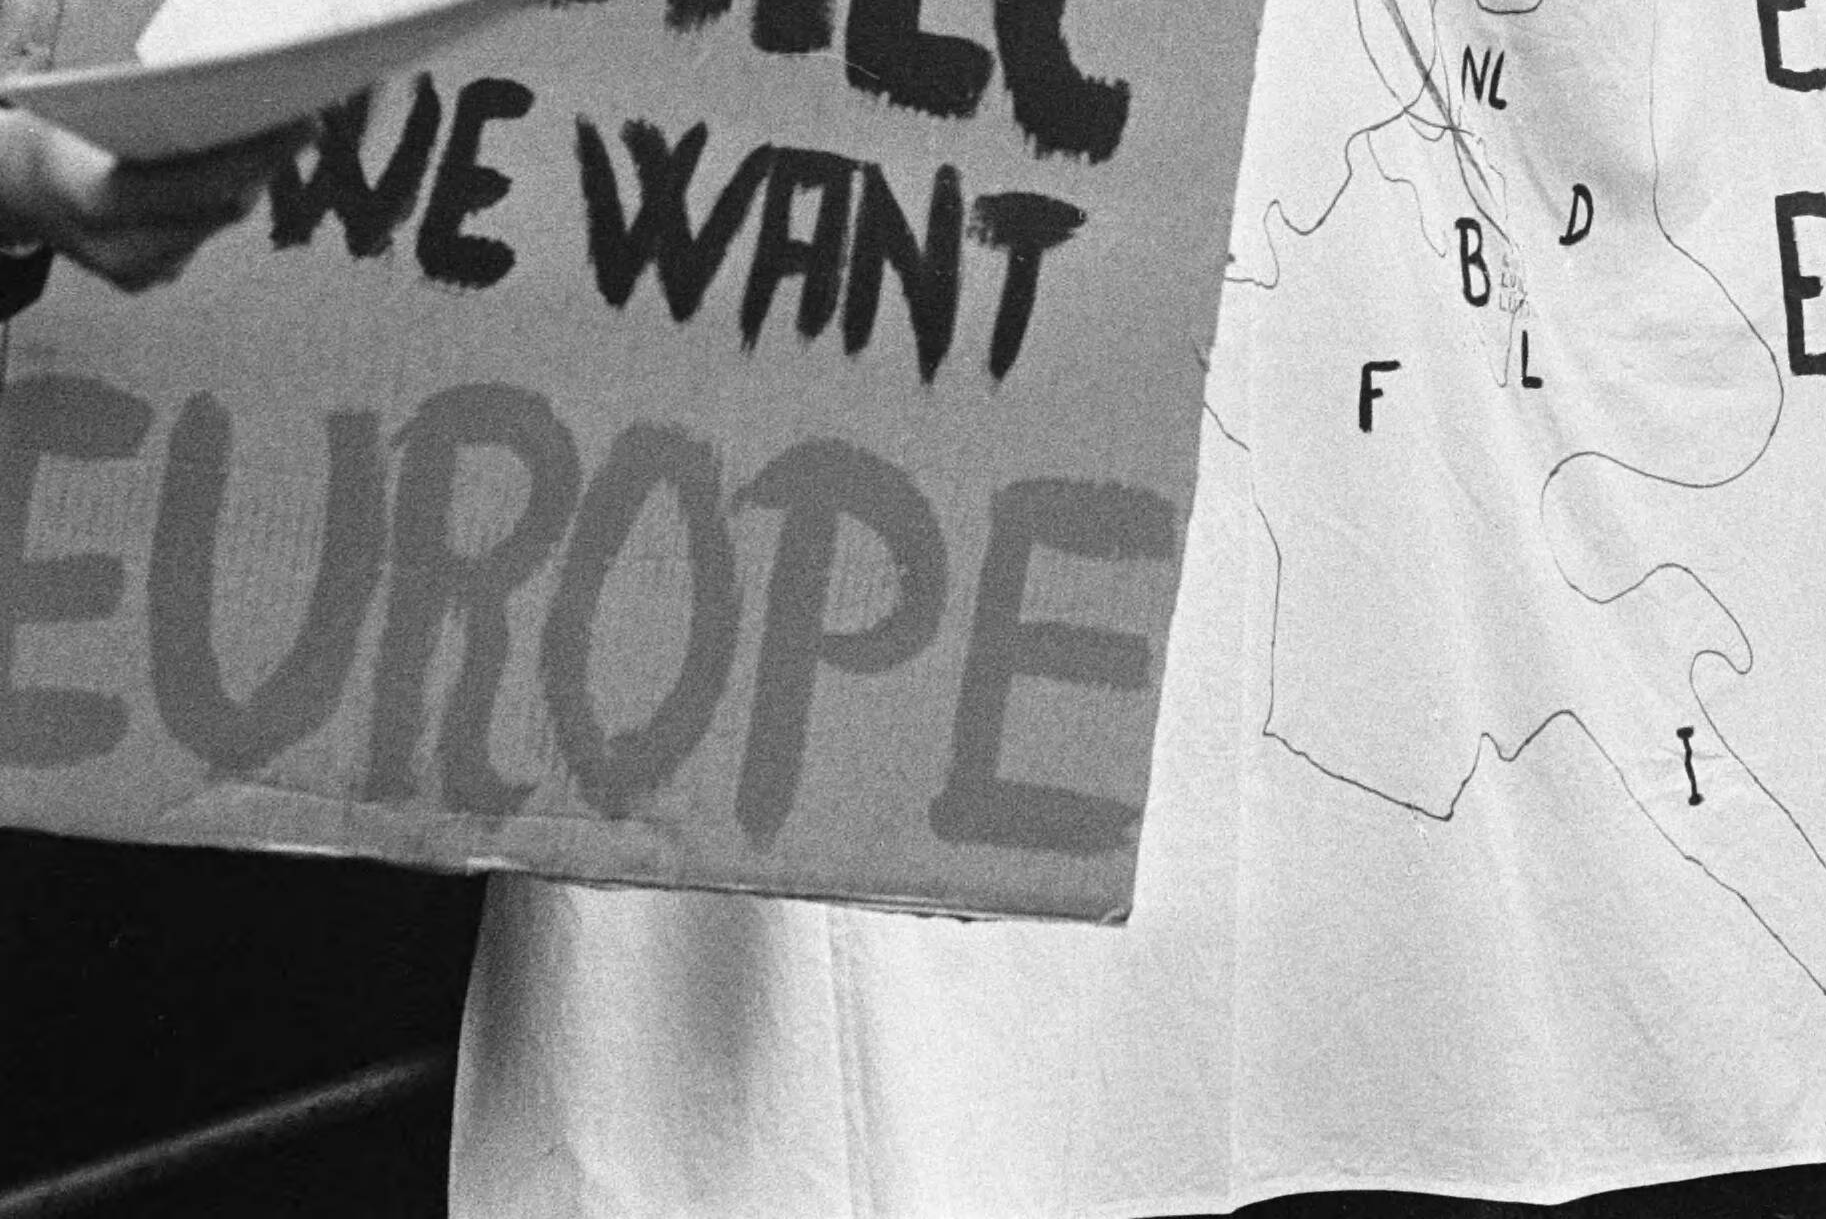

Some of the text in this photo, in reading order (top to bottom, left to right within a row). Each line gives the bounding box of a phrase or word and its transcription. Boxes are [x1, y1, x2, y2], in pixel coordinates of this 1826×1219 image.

[1459, 45, 1508, 110] NL
[262, 71, 1088, 388] WE WANT
[1559, 183, 1594, 246] D
[1455, 217, 1491, 307] B
[1358, 360, 1400, 433] F
[1521, 330, 1543, 389] L
[0, 373, 1190, 856] EUROPE
[1675, 726, 1705, 807] I
